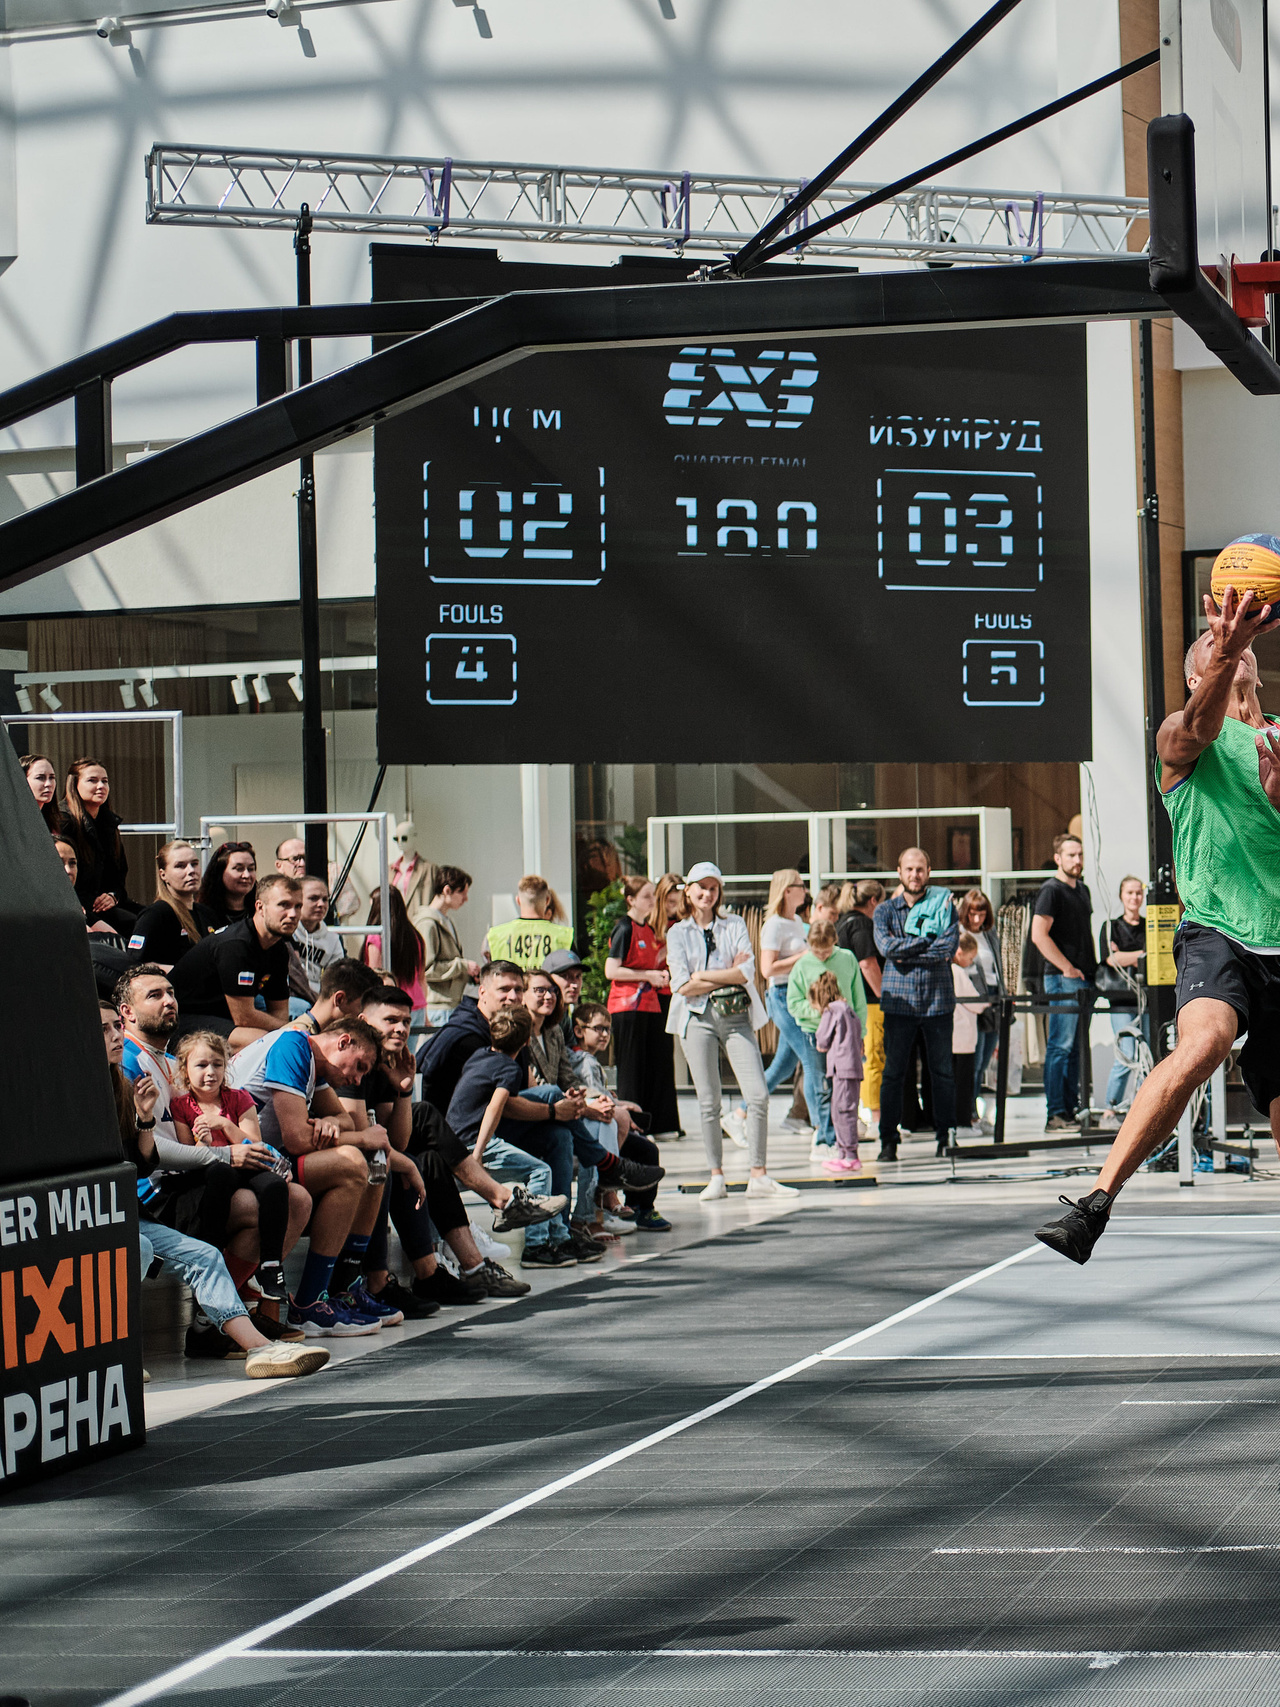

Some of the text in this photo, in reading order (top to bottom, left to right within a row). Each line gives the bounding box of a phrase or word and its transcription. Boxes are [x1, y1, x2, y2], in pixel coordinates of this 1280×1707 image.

[869, 415, 1043, 452] ИЗУМРУД
[458, 481, 574, 560] 02
[907, 491, 1014, 567] 03
[439, 604, 504, 624] FOULS
[974, 613, 1033, 630] FOULS
[455, 646, 489, 682] 4
[990, 650, 1018, 685] 5
[506, 934, 552, 959] 14978
[47, 1181, 126, 1236] MALL
